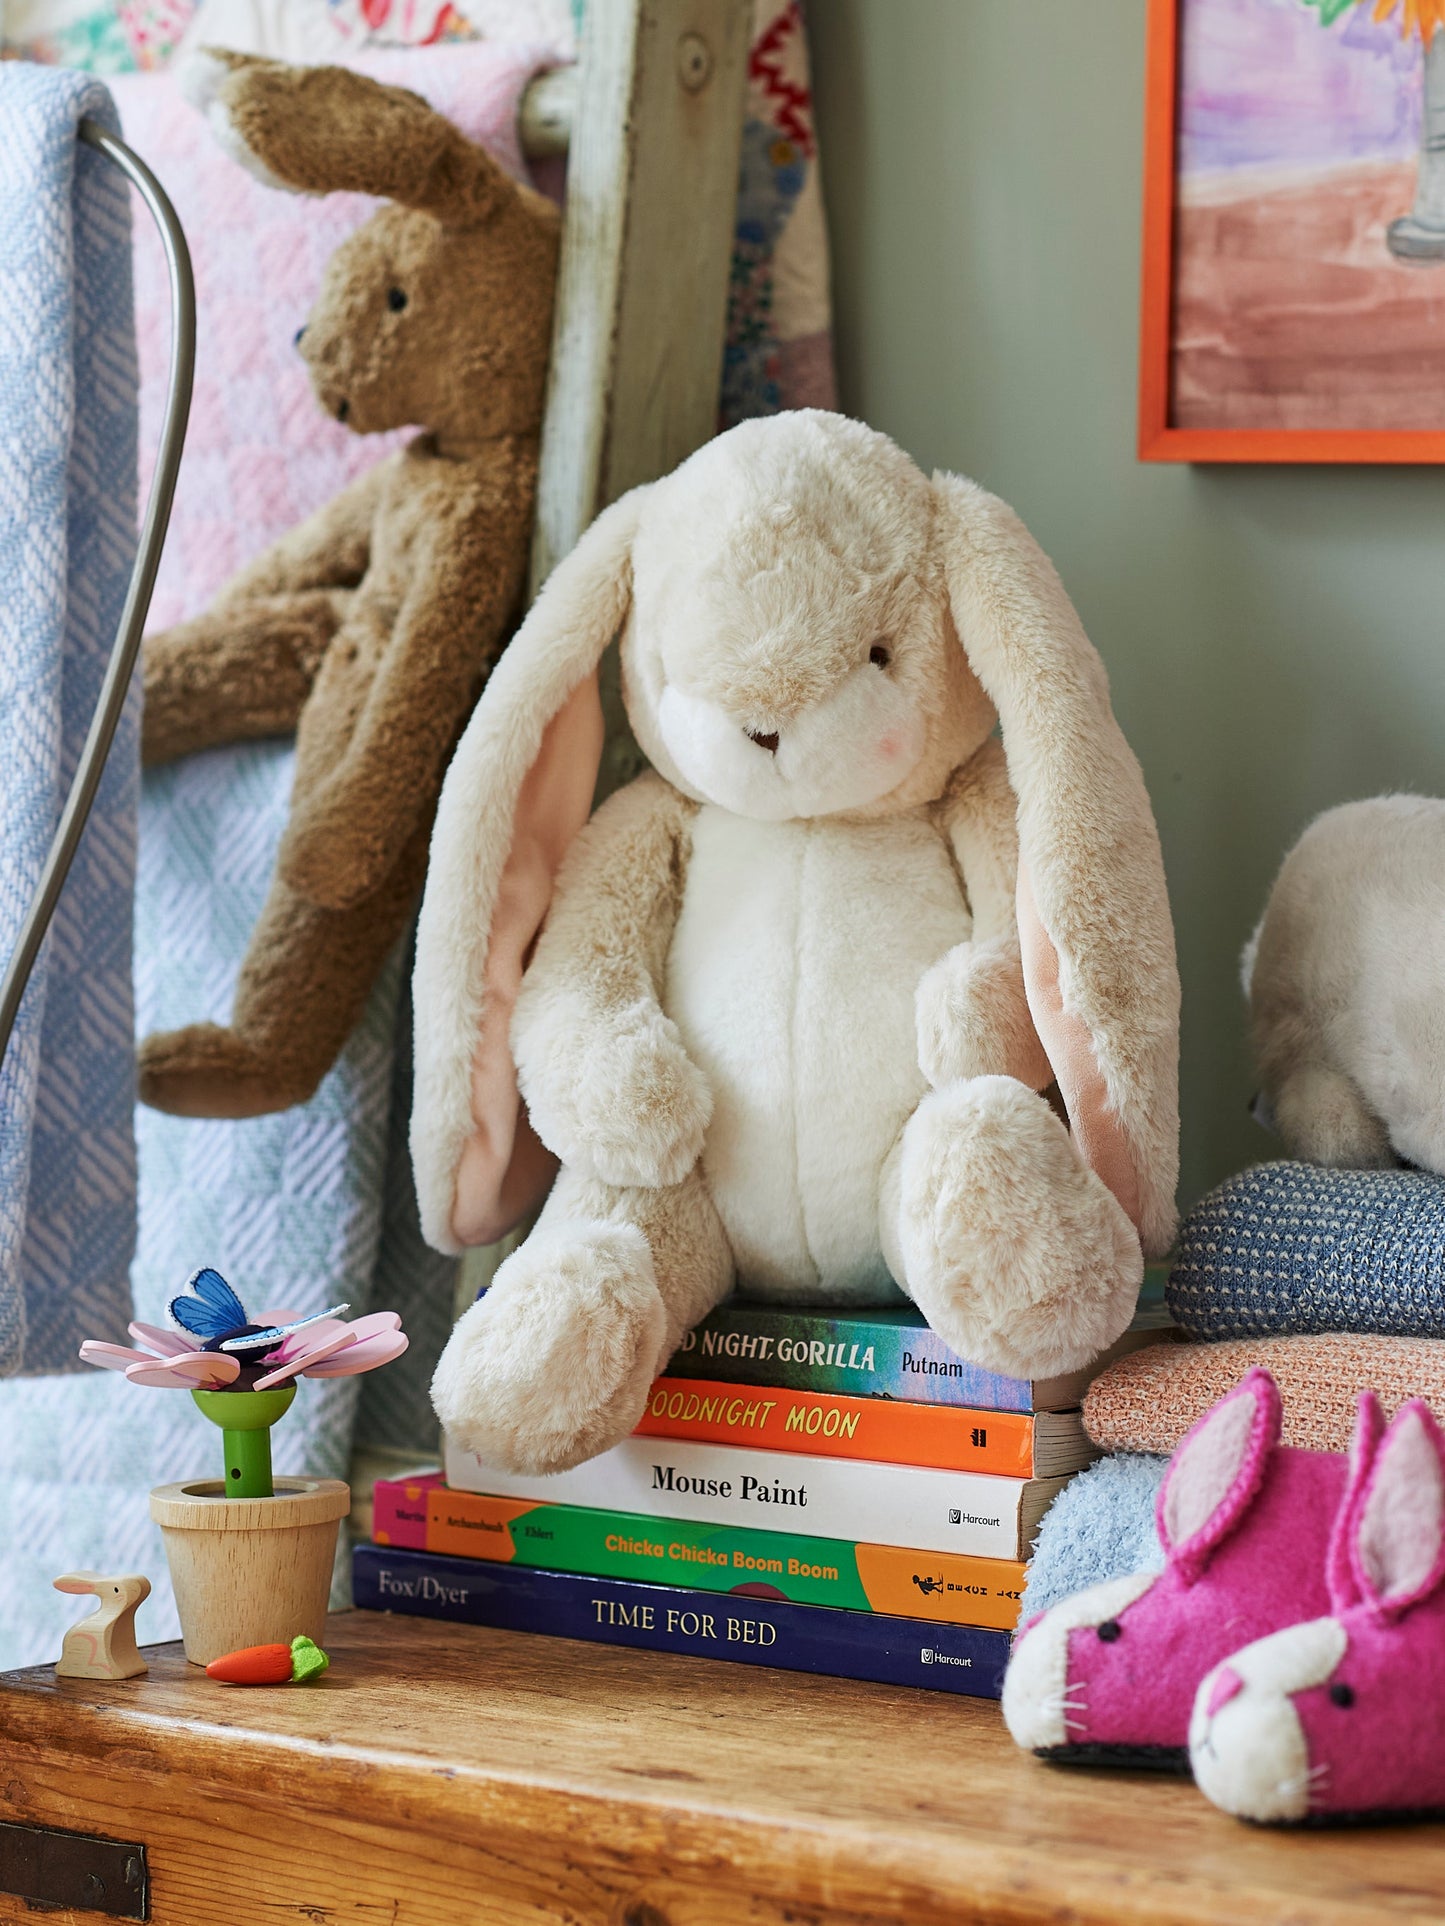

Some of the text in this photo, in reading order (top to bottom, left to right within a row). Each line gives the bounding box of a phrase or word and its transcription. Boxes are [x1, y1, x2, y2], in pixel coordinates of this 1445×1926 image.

[777, 1338, 876, 1373] GORILLA
[902, 1351, 963, 1378] Putnam
[645, 1390, 862, 1440] OODNIGHT MOON
[651, 1465, 808, 1507] Mouse Paint
[396, 1509, 426, 1523] Martin
[525, 1526, 554, 1540] Ehlert
[962, 1512, 999, 1527] Harcourt
[604, 1534, 840, 1582] Chicka Chicka Boom Boom
[378, 1570, 469, 1606] Fox/Dyer
[947, 1583, 1021, 1600] BEACH LAN
[592, 1599, 777, 1647] TIME FOR BED
[935, 1654, 972, 1668] Harcourt
